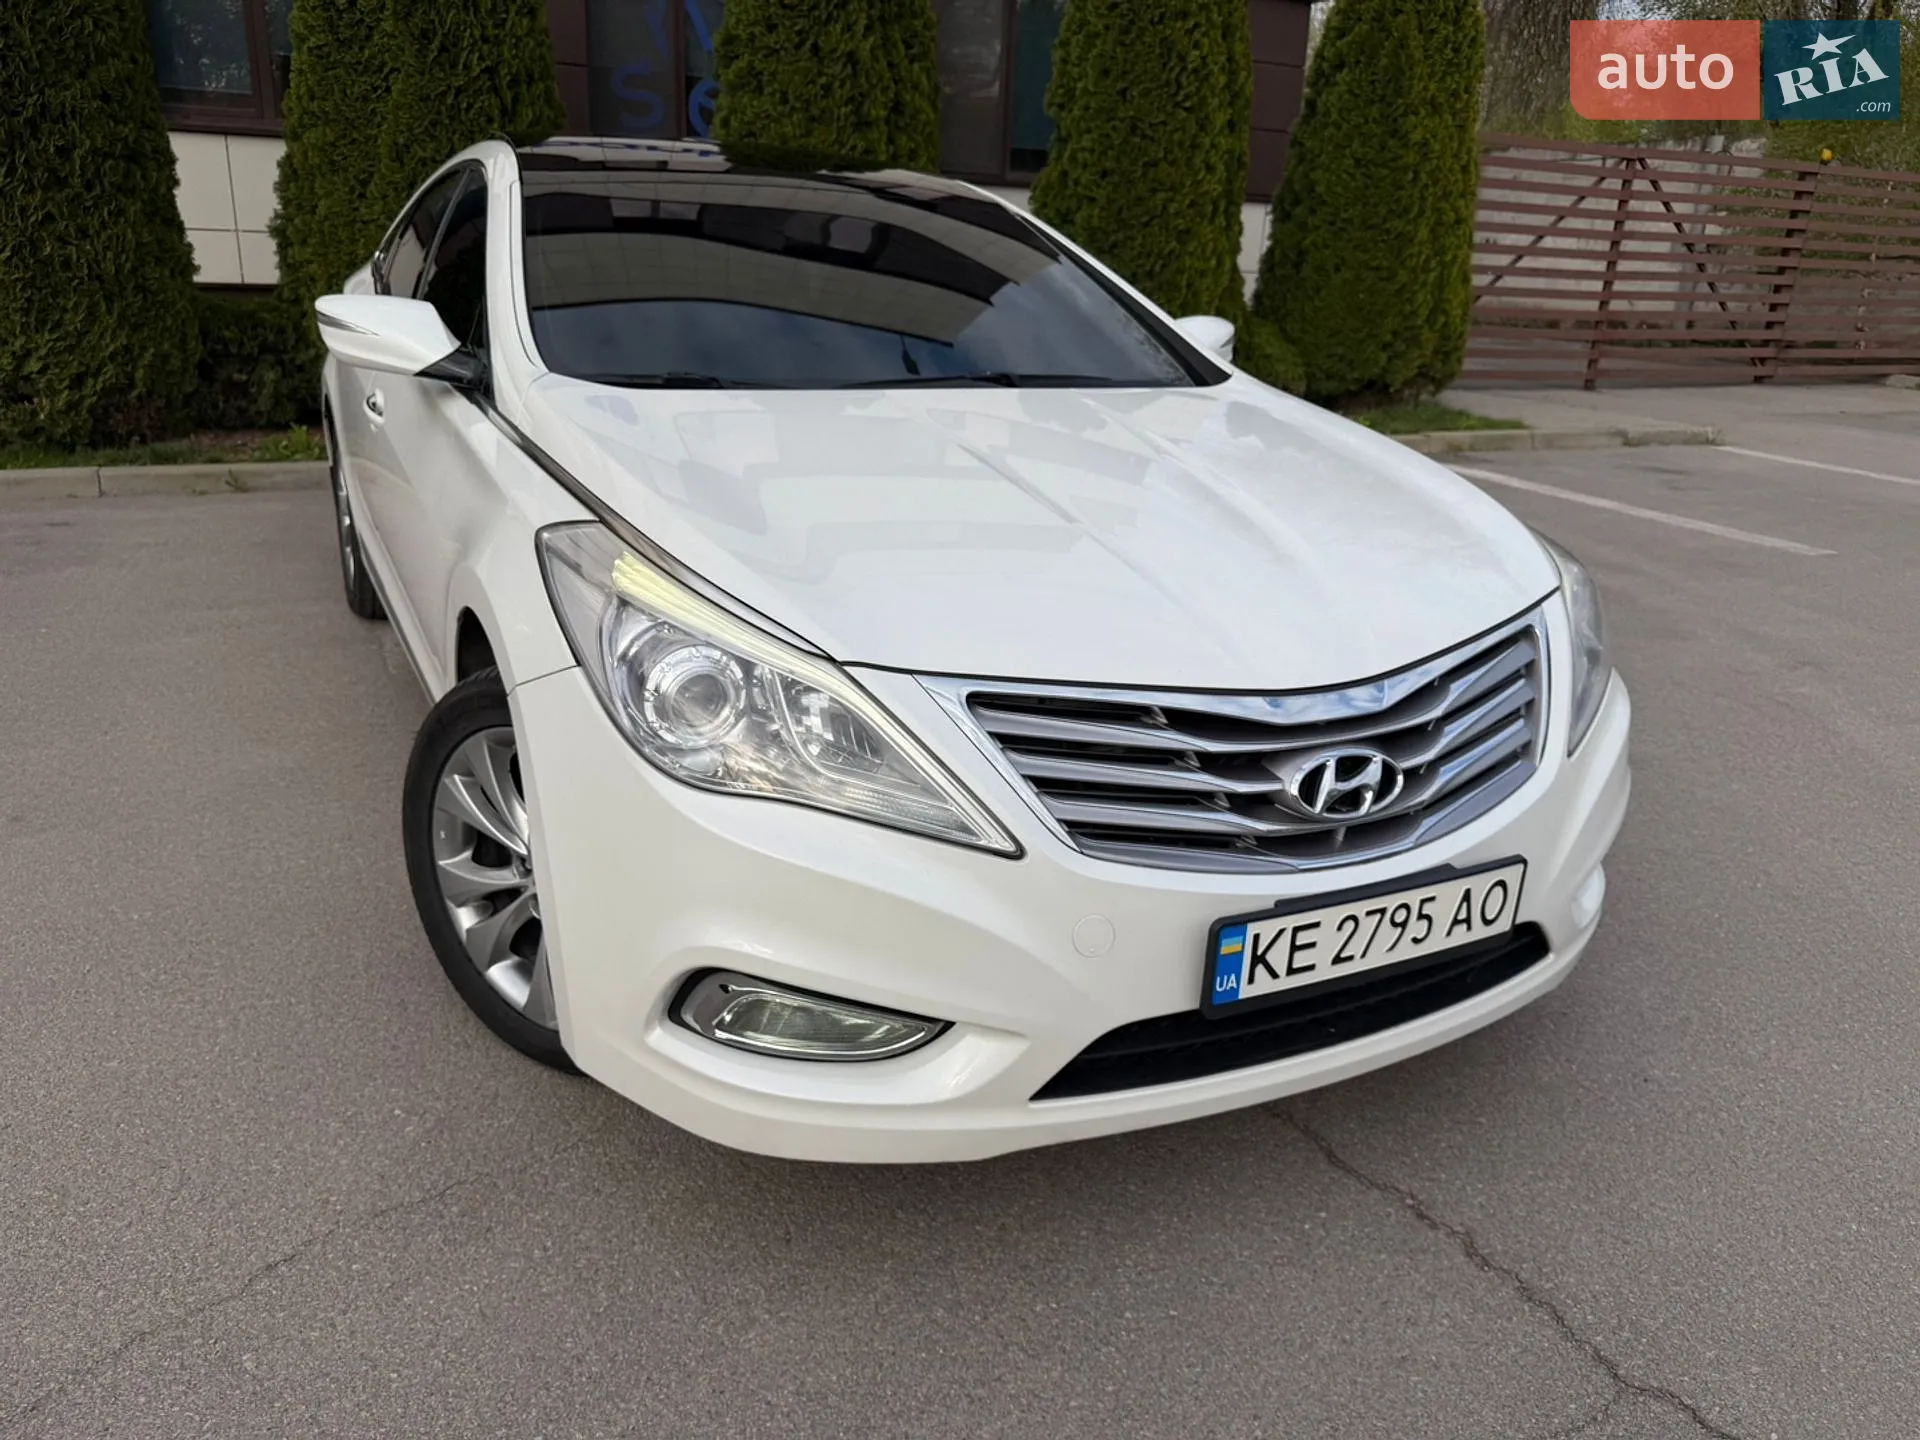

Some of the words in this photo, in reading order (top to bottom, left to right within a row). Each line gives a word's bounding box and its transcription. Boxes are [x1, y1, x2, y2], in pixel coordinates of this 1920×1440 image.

[1246, 921, 1321, 985] KE
[1330, 896, 1437, 967] 2795
[1445, 879, 1508, 938] AO
[1215, 973, 1238, 992] UA
